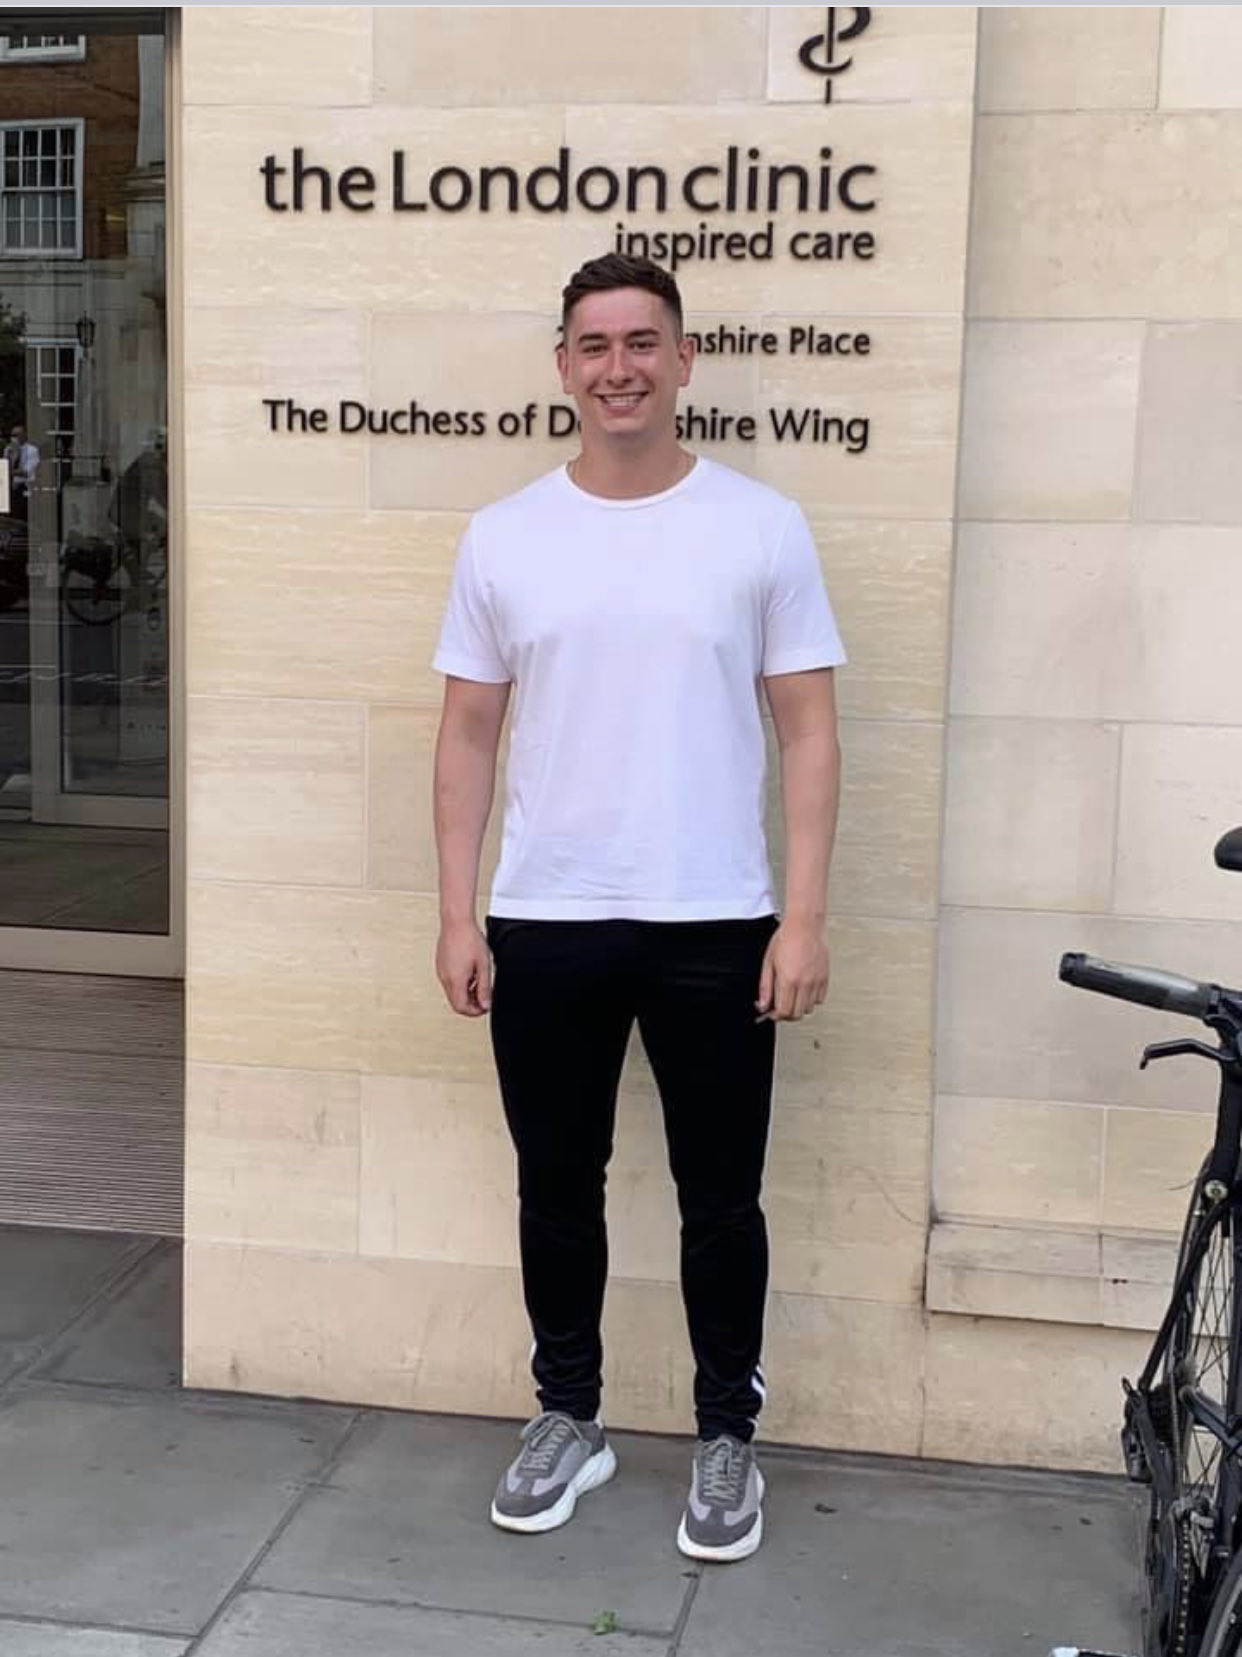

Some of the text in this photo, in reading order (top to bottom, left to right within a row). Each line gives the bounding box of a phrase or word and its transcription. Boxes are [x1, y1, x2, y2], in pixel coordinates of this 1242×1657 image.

[259, 145, 877, 214] the London clinic
[615, 221, 875, 271] inspired care
[685, 324, 871, 356] nshire Place
[263, 398, 870, 455] The Duchess of Dshire Wing
